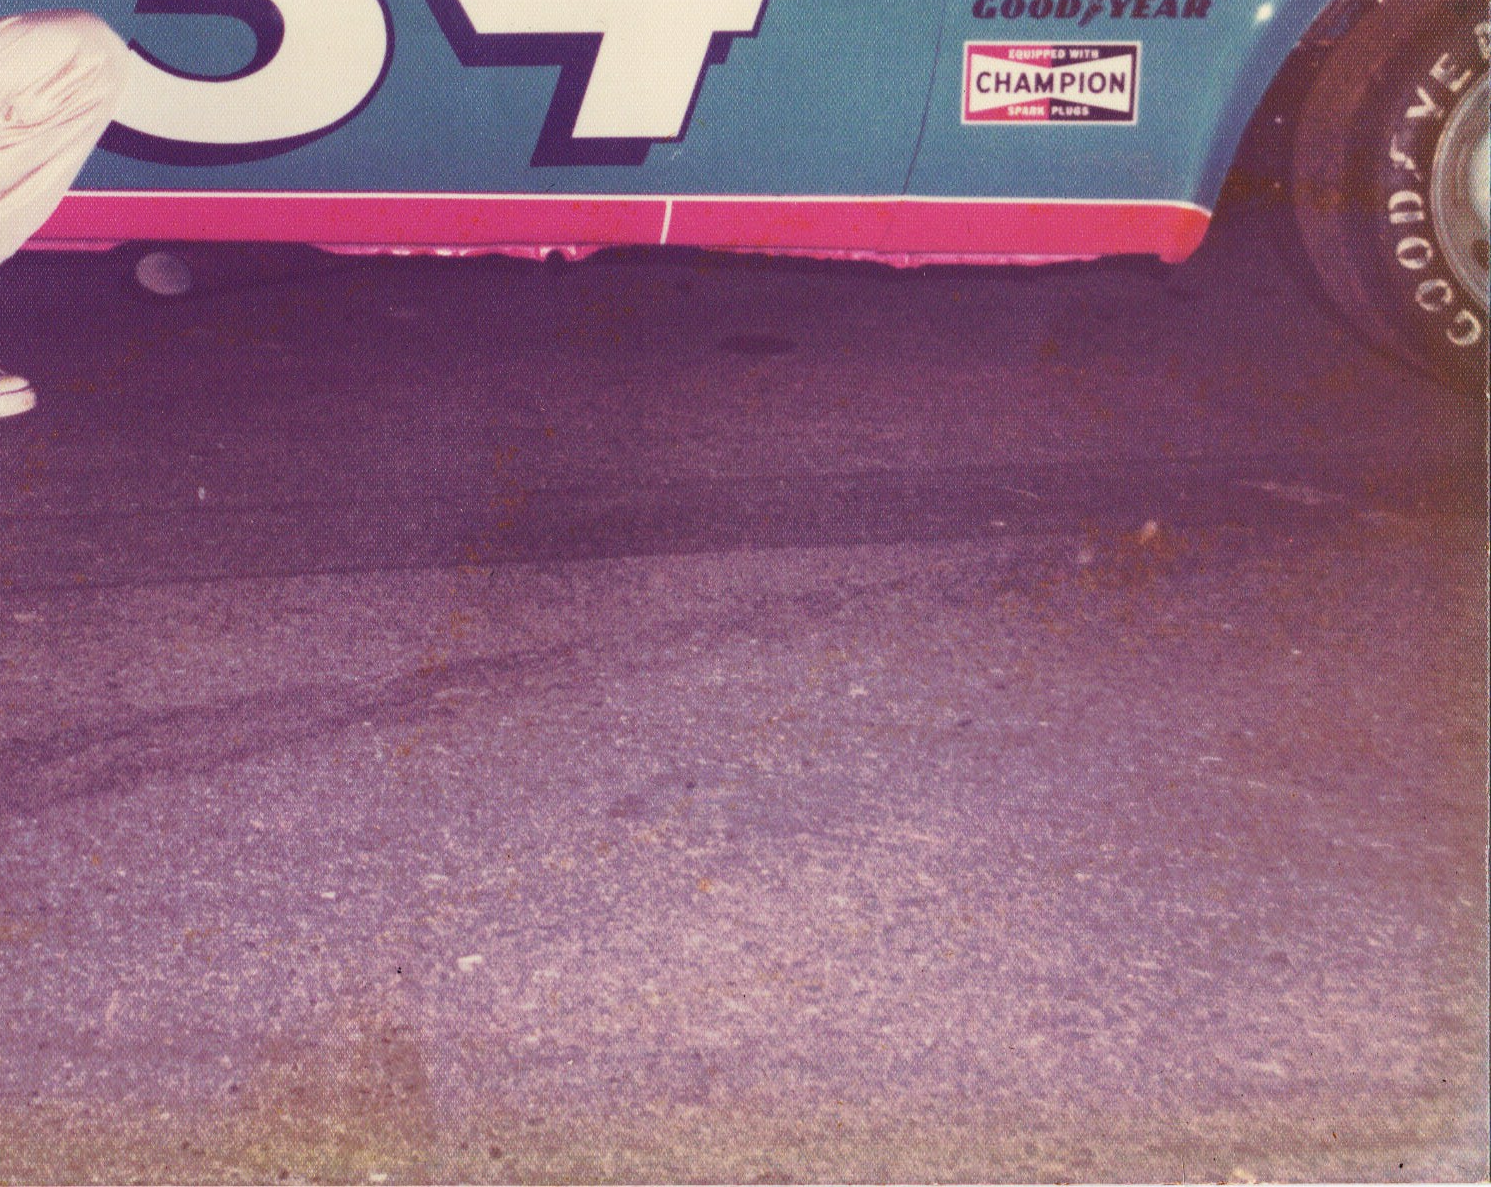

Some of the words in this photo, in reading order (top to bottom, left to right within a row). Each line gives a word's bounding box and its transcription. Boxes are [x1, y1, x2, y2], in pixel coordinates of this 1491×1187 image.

[1008, 48, 1066, 60] EQUIPPED
[1069, 48, 1100, 60] WITH
[975, 71, 1126, 94] CHAMPION
[1007, 105, 1046, 117] SPARK
[1050, 105, 1090, 117] PLUGS
